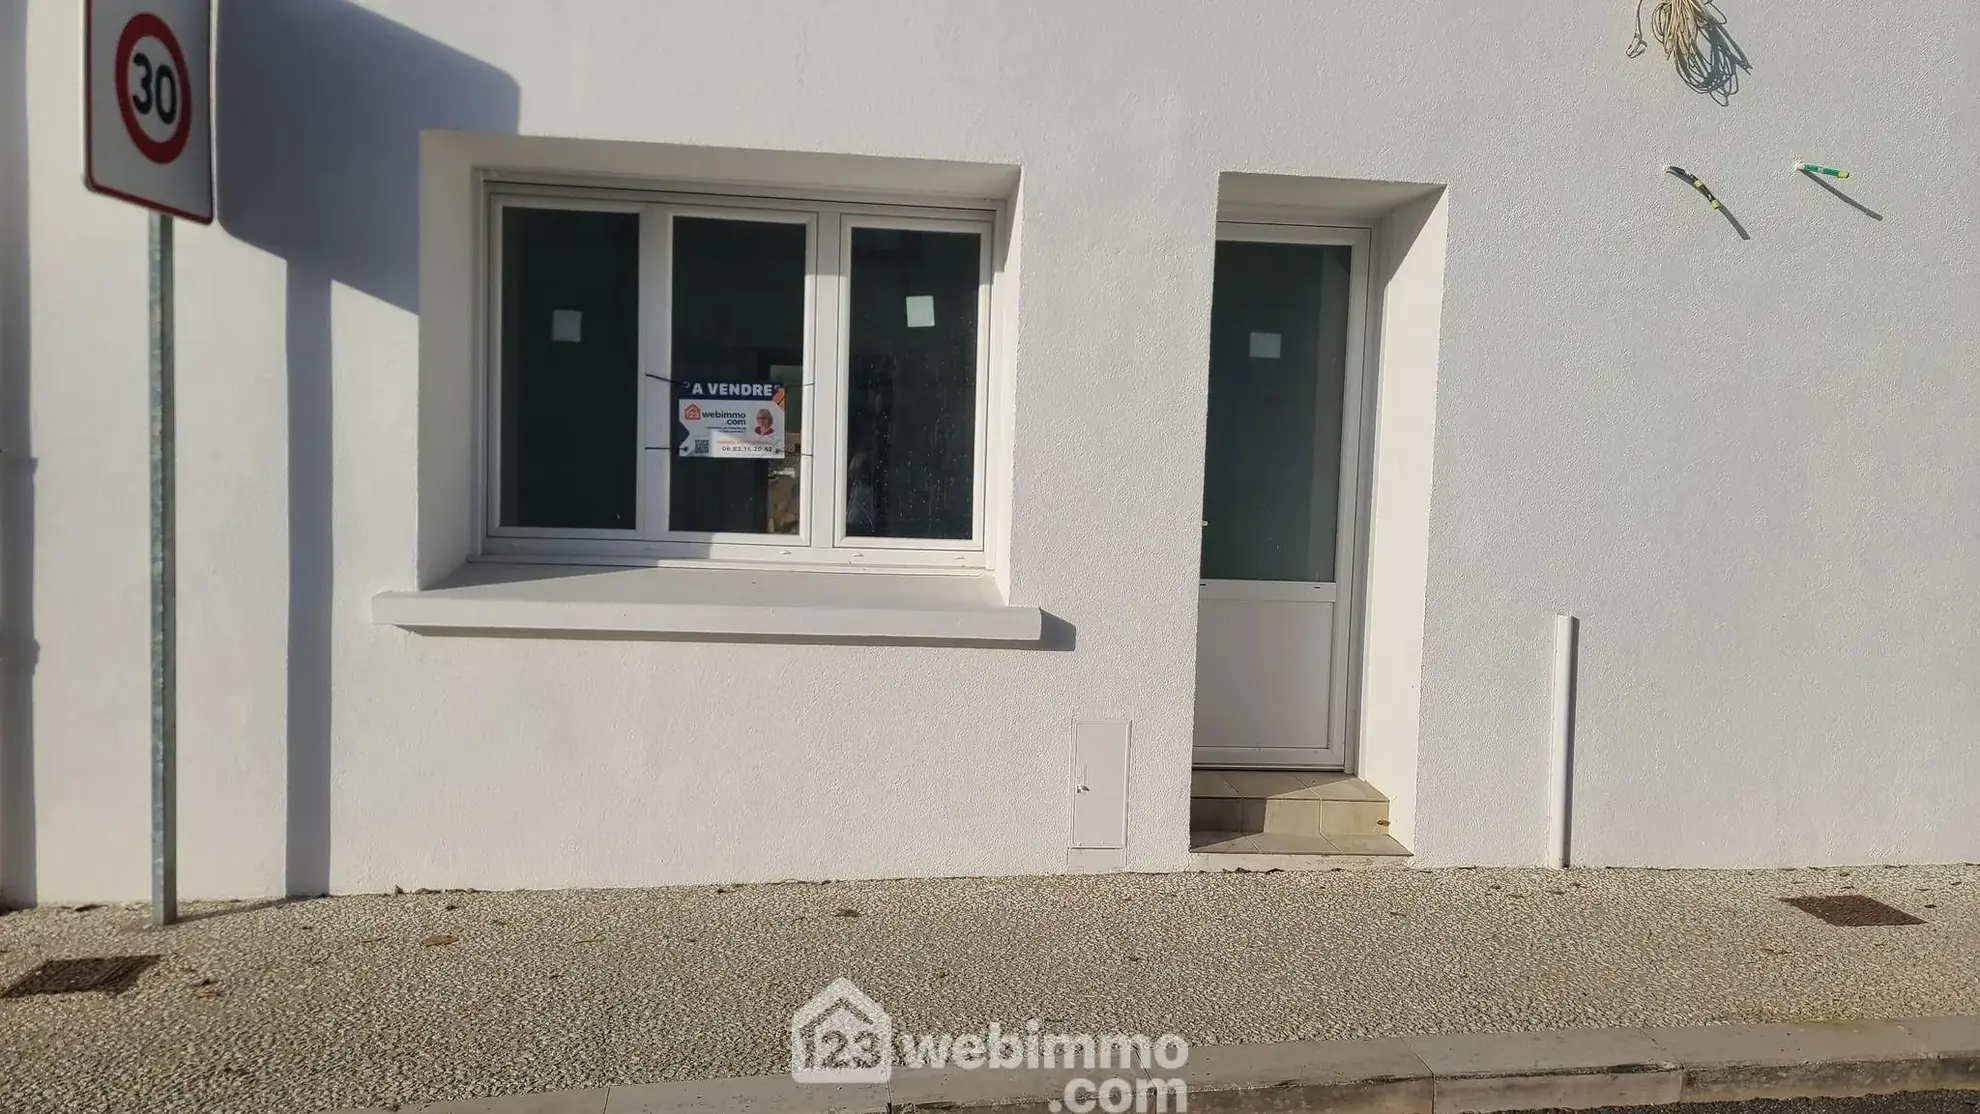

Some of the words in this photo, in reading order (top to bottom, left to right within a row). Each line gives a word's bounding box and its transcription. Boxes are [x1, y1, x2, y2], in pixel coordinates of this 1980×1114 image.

[132, 52, 178, 125] 30
[692, 382, 704, 395] A
[707, 383, 773, 397] VENDRE
[702, 410, 746, 419] webimmo
